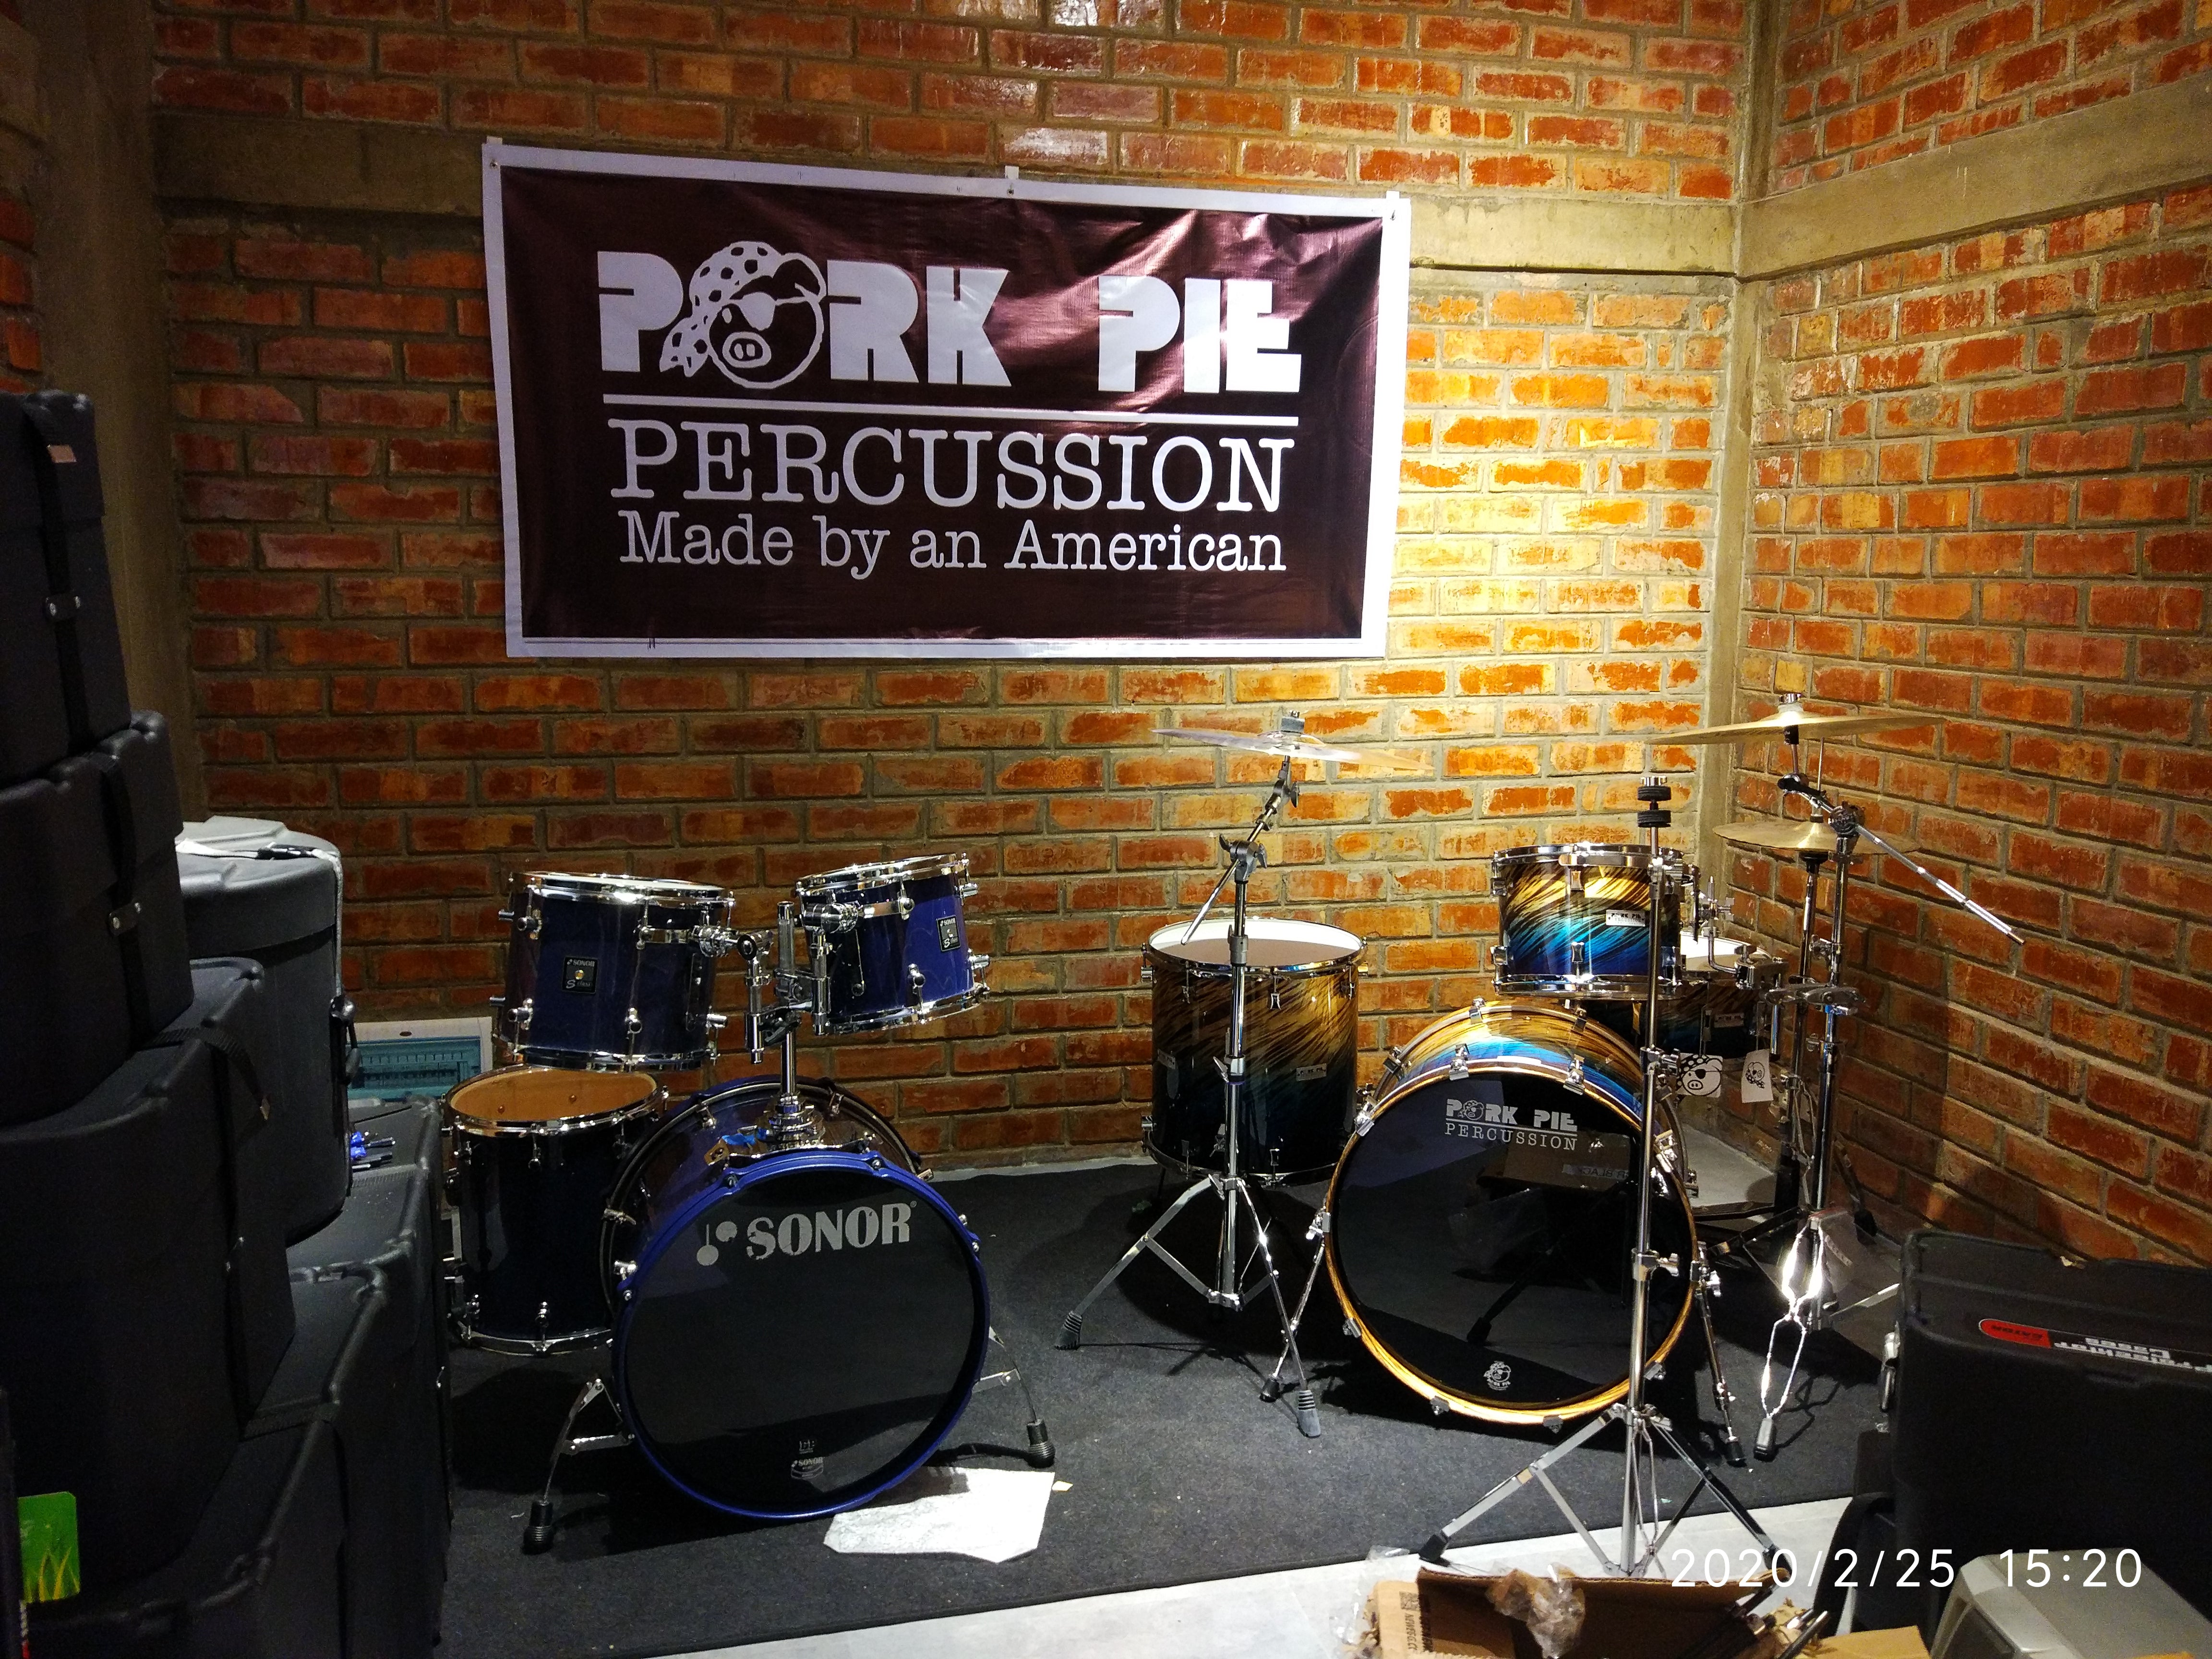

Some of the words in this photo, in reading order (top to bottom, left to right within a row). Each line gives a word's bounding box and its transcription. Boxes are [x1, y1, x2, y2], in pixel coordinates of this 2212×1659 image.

[1098, 275, 1302, 394] PIE
[608, 419, 1295, 513] PERCUSSION
[618, 510, 794, 565] Made
[812, 515, 891, 580] by
[909, 529, 988, 568] an
[1003, 519, 1287, 572] American
[1444, 1122, 1578, 1151] PERCUSSION
[1533, 1109, 1578, 1132] PIE
[746, 1202, 912, 1260] SONOR
